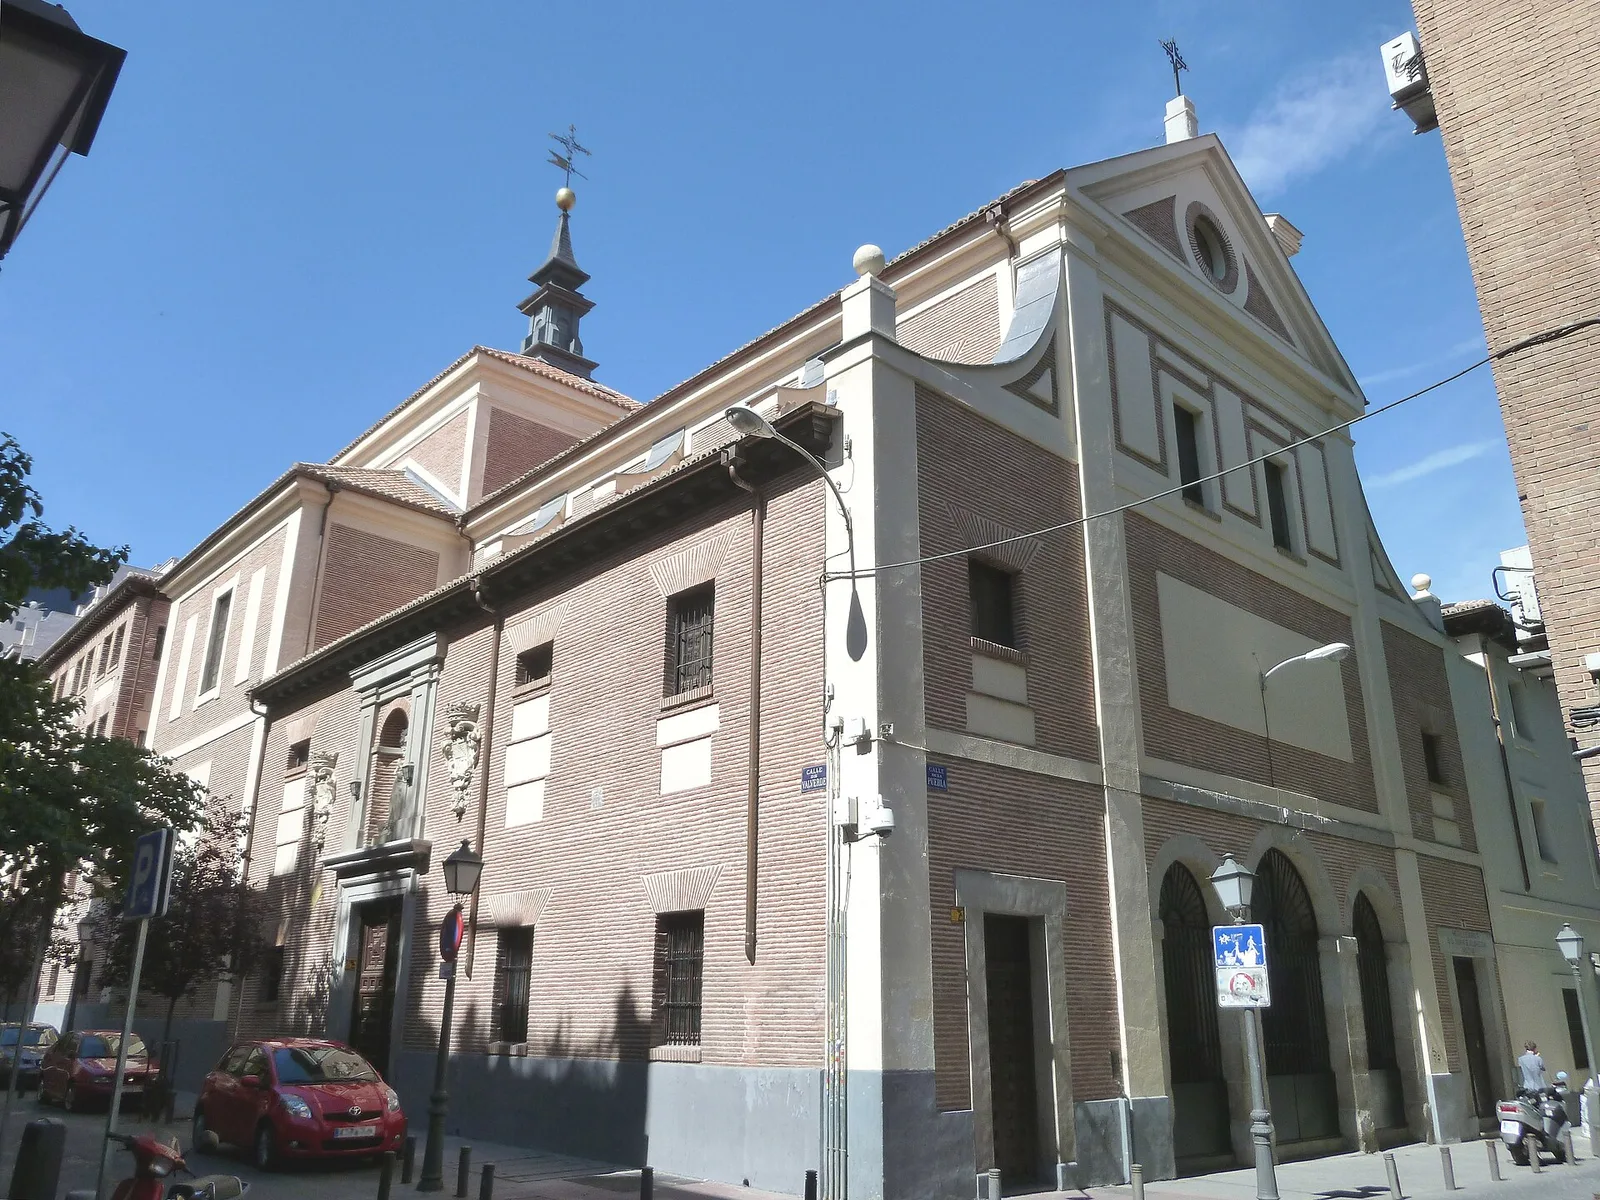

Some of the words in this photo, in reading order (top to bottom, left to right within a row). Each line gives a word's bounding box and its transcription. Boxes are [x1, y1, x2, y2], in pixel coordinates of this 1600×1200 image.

[806, 767, 823, 775] CALLE
[929, 766, 944, 774] CALLE
[802, 778, 826, 789] VALVERDE
[928, 777, 946, 788] PUEBLA
[130, 844, 153, 908] P
